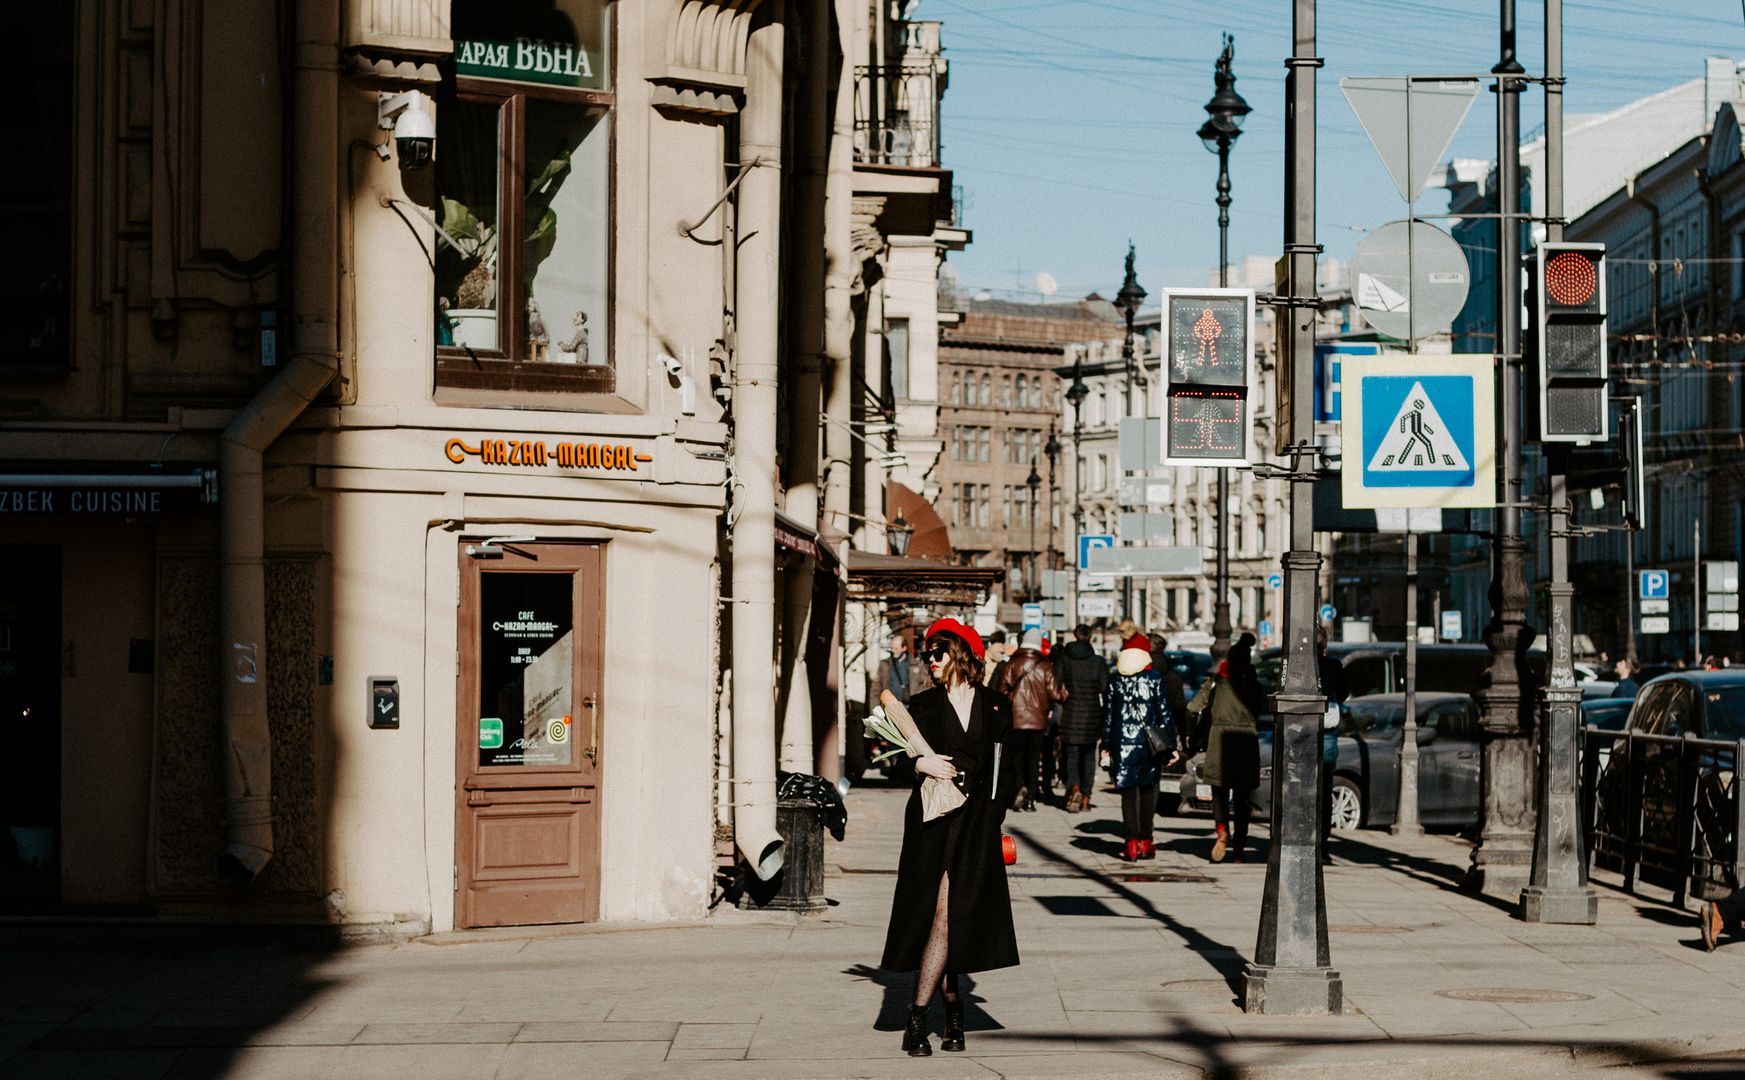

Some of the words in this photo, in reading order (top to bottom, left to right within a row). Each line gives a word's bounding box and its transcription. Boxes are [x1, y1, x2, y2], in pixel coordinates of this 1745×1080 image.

[456, 41, 510, 68] АРАЯ
[481, 439, 638, 471] KAZAN-MANGAL
[71, 491, 161, 512] CUISINE
[518, 611, 535, 621] CAFE
